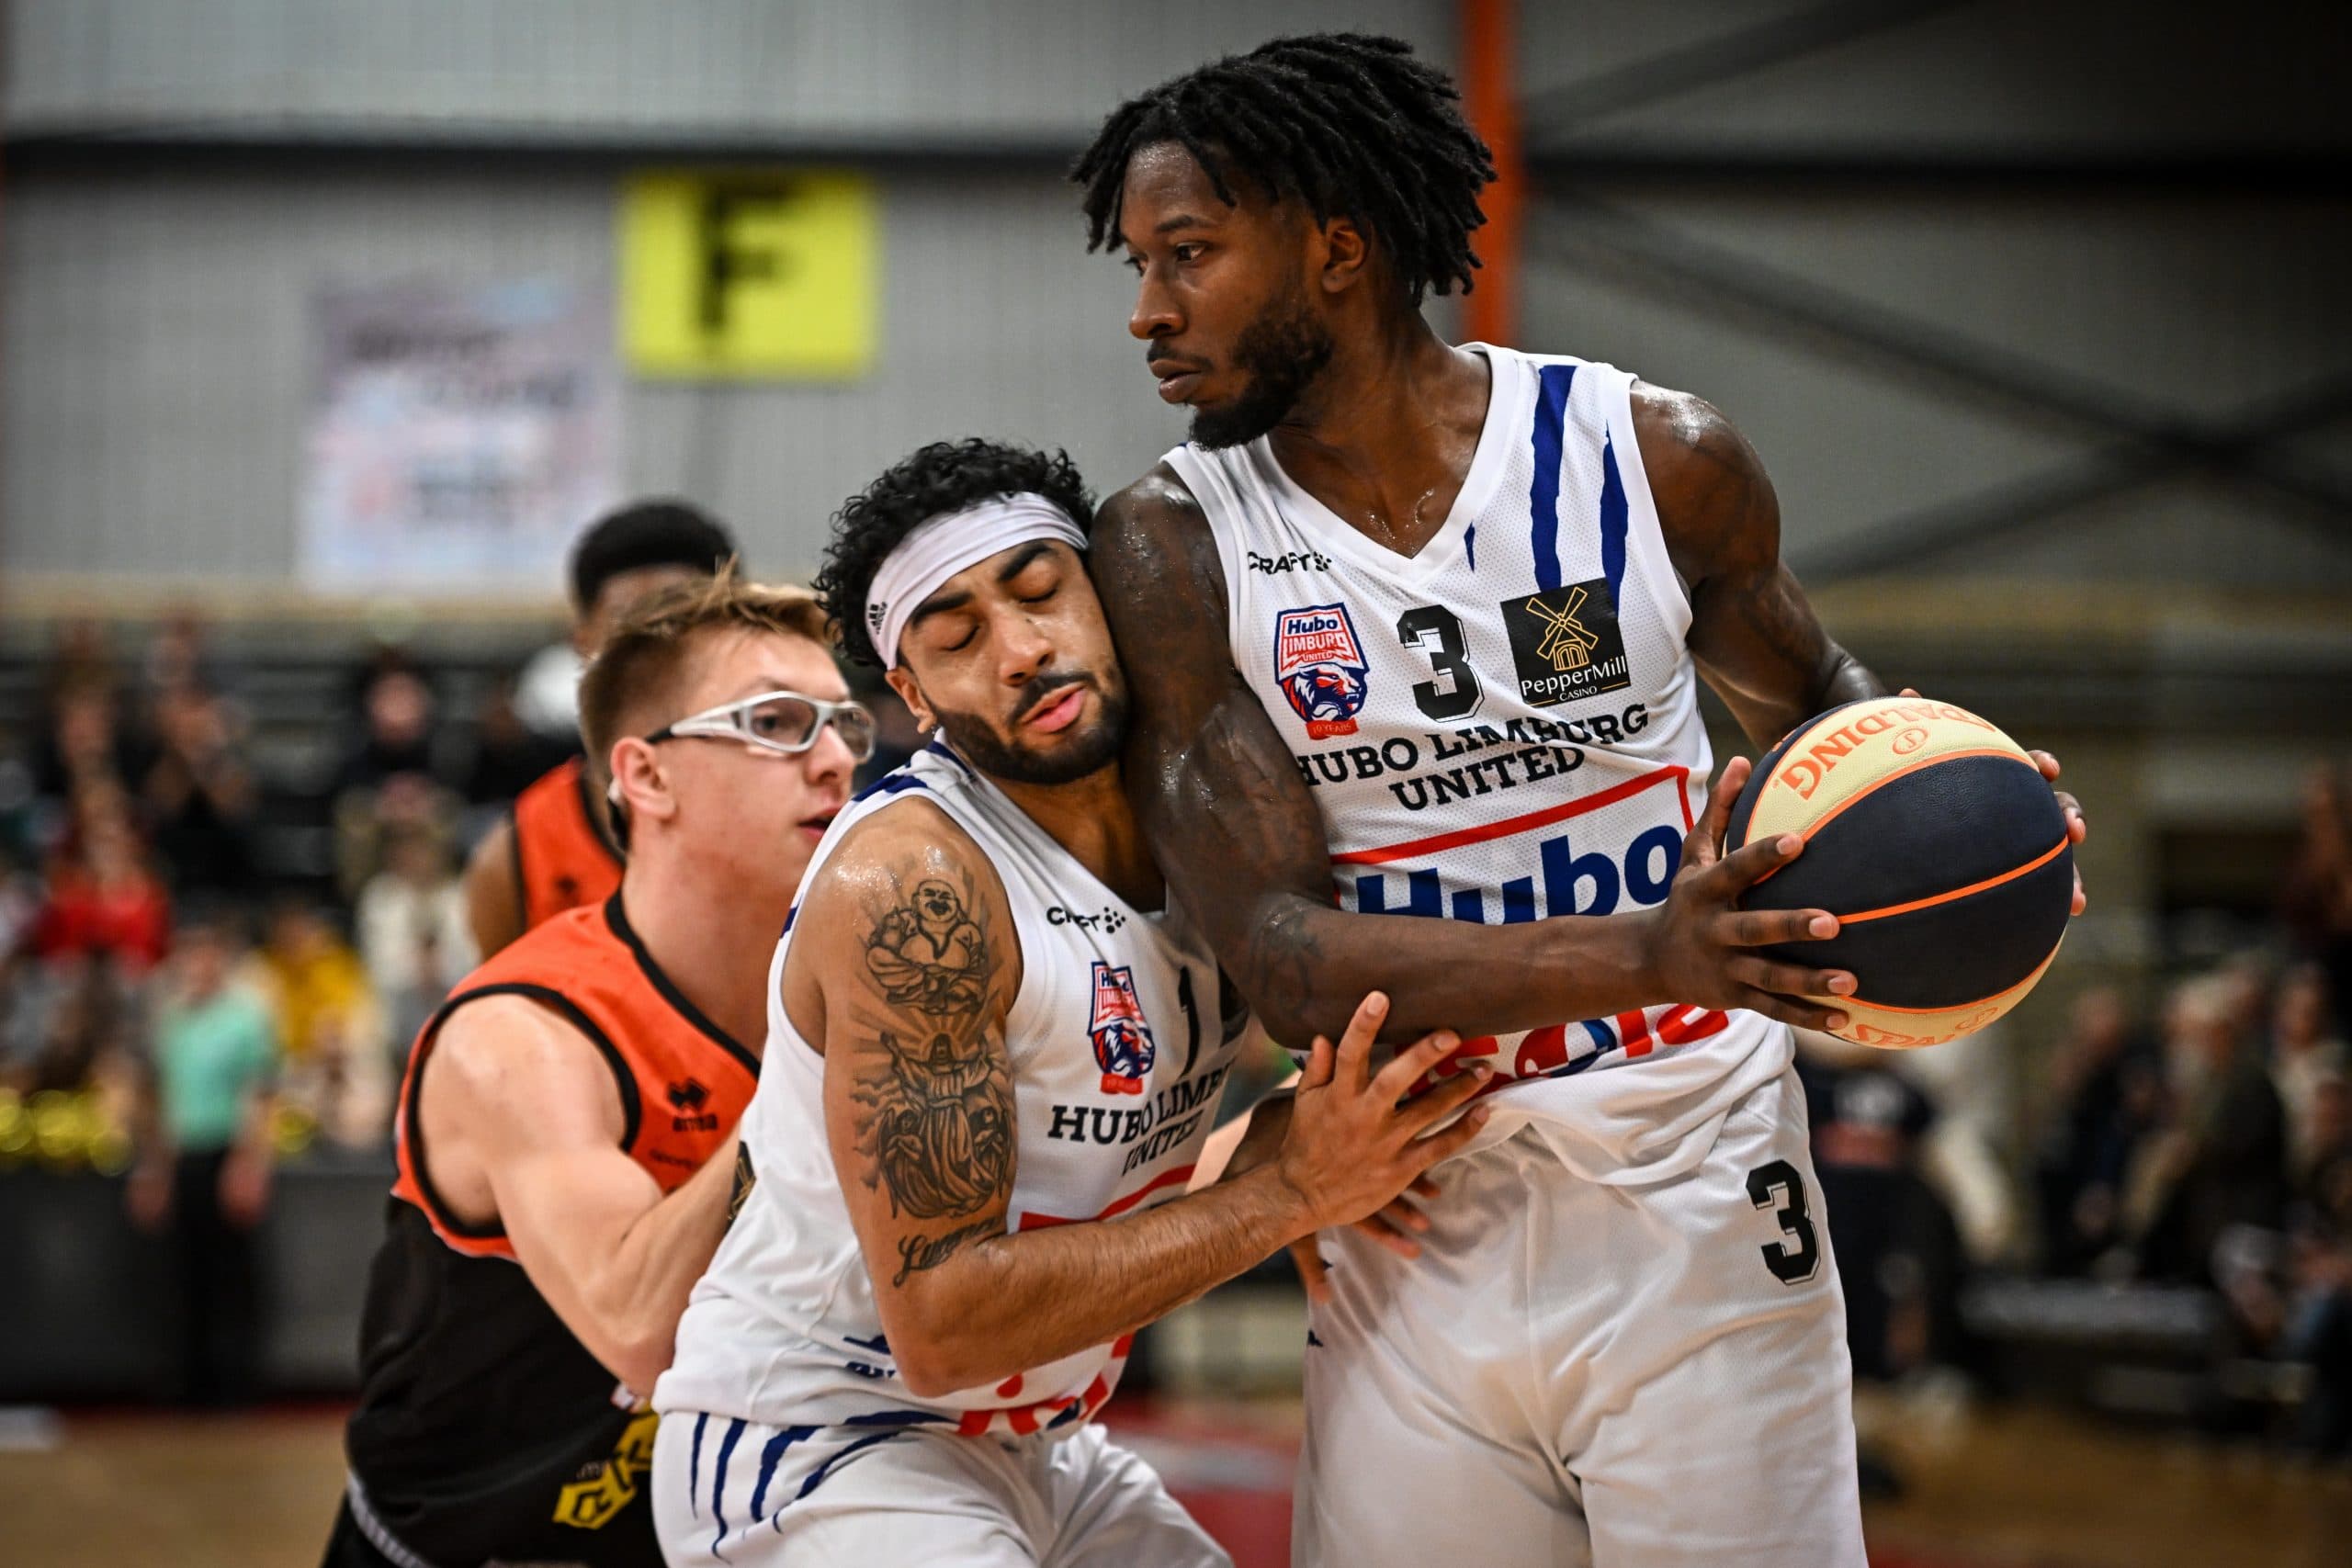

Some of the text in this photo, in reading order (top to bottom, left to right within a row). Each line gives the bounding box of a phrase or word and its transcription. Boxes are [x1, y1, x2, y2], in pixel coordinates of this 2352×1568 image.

[696, 180, 794, 338] F
[1248, 551, 1310, 575] CRAFT
[1287, 616, 1338, 635] Hubo
[1302, 652, 1333, 662] UNITED
[1396, 604, 1485, 723] 3
[1521, 655, 1627, 696] PepperMill
[1559, 686, 1598, 701] CASINO
[1297, 704, 1648, 786] HUBO LIMBURG
[1323, 723, 1351, 733] YEARS
[1388, 745, 1585, 810] UNITED
[1047, 1100, 1153, 1145] HUBO
[1746, 1159, 1822, 1286] 3
